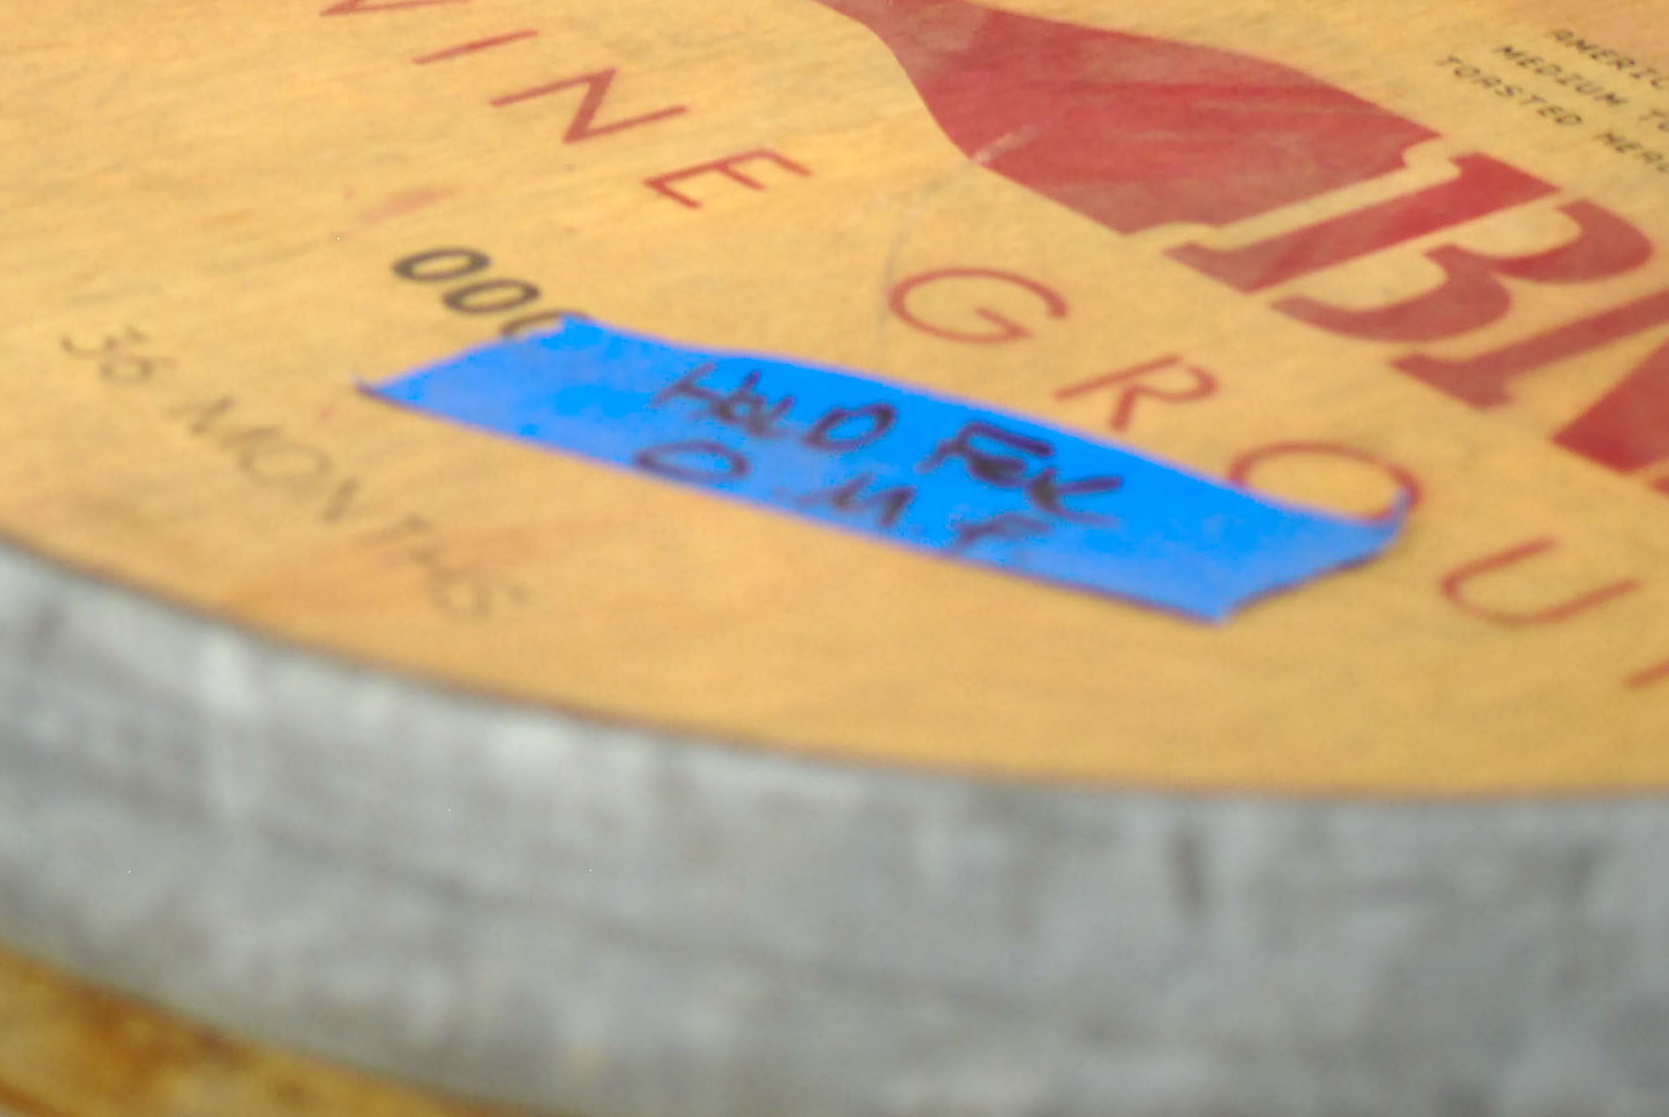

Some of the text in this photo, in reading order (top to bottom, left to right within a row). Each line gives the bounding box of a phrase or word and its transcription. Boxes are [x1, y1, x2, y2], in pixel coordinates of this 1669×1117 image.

[1435, 55, 1582, 126] TOASTED
[1492, 45, 1629, 107] MEDIUM
[1162, 151, 1669, 499] BN
[888, 265, 1669, 691] GROU
